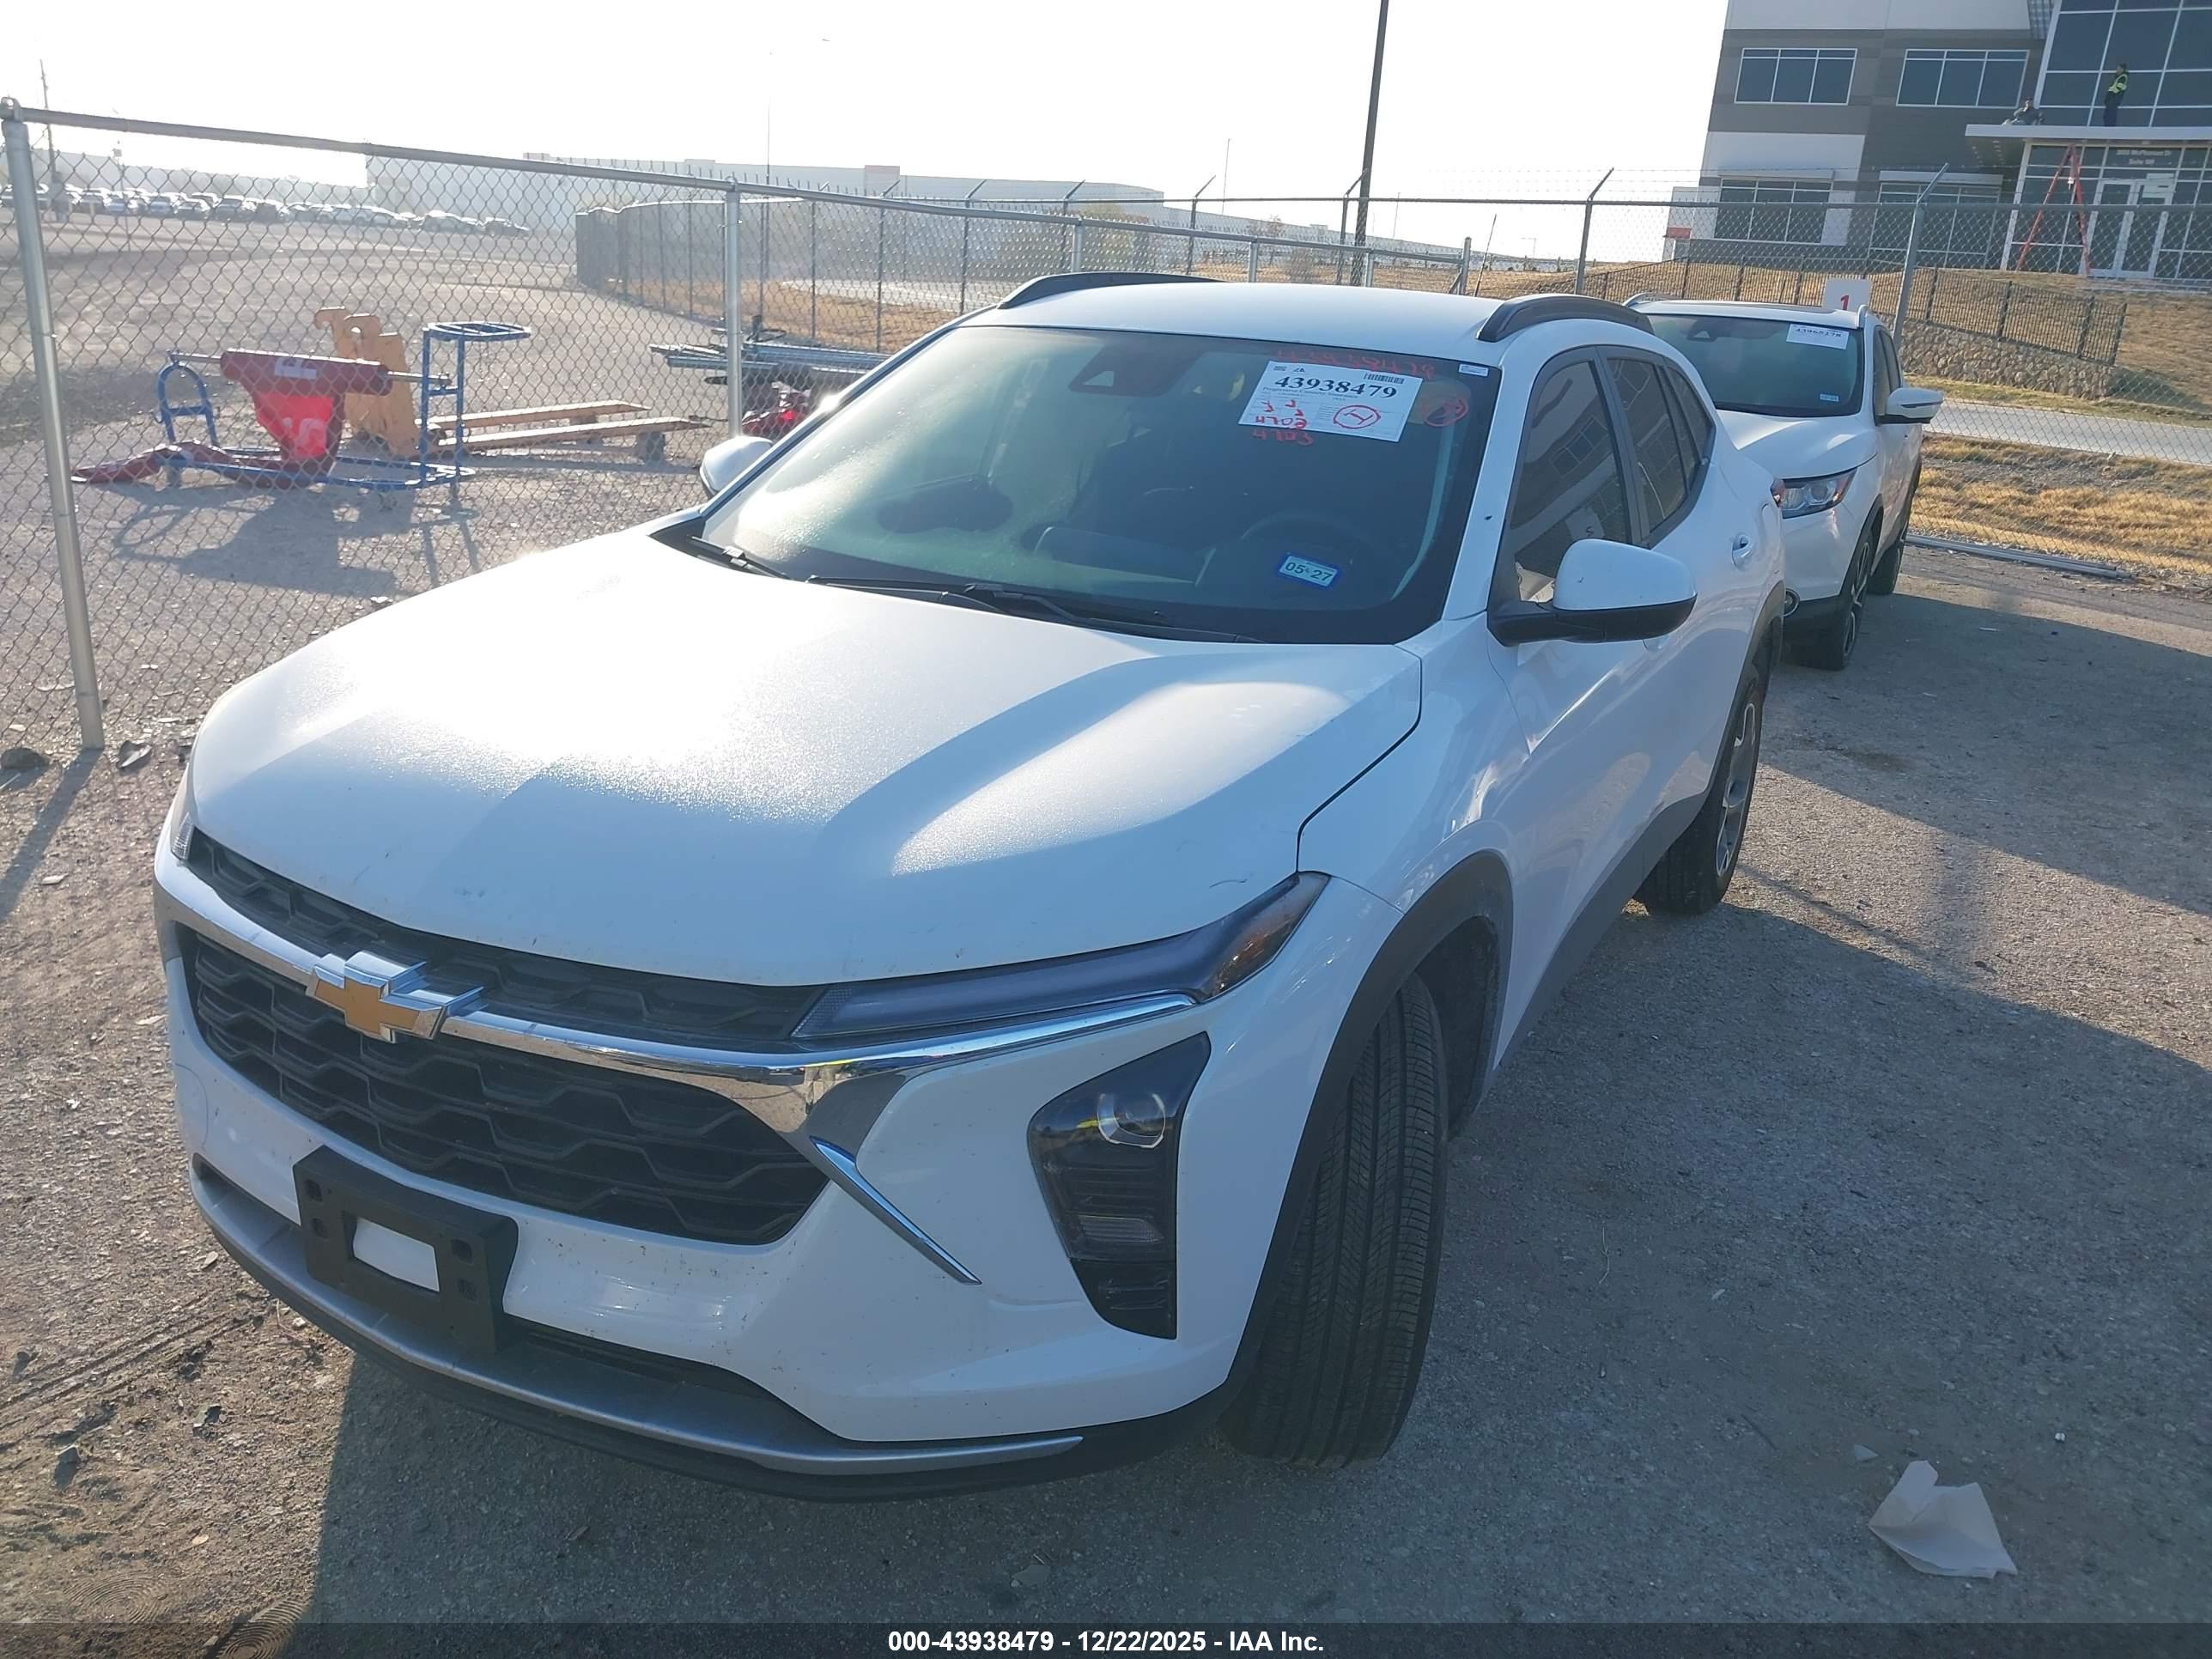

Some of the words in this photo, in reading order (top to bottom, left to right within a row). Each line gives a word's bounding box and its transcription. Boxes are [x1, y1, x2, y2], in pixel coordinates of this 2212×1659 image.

[1840, 295, 1850, 311] 1
[1274, 376, 1396, 398] 43938479
[1285, 562, 1305, 574] 05
[1310, 569, 1334, 581] 27
